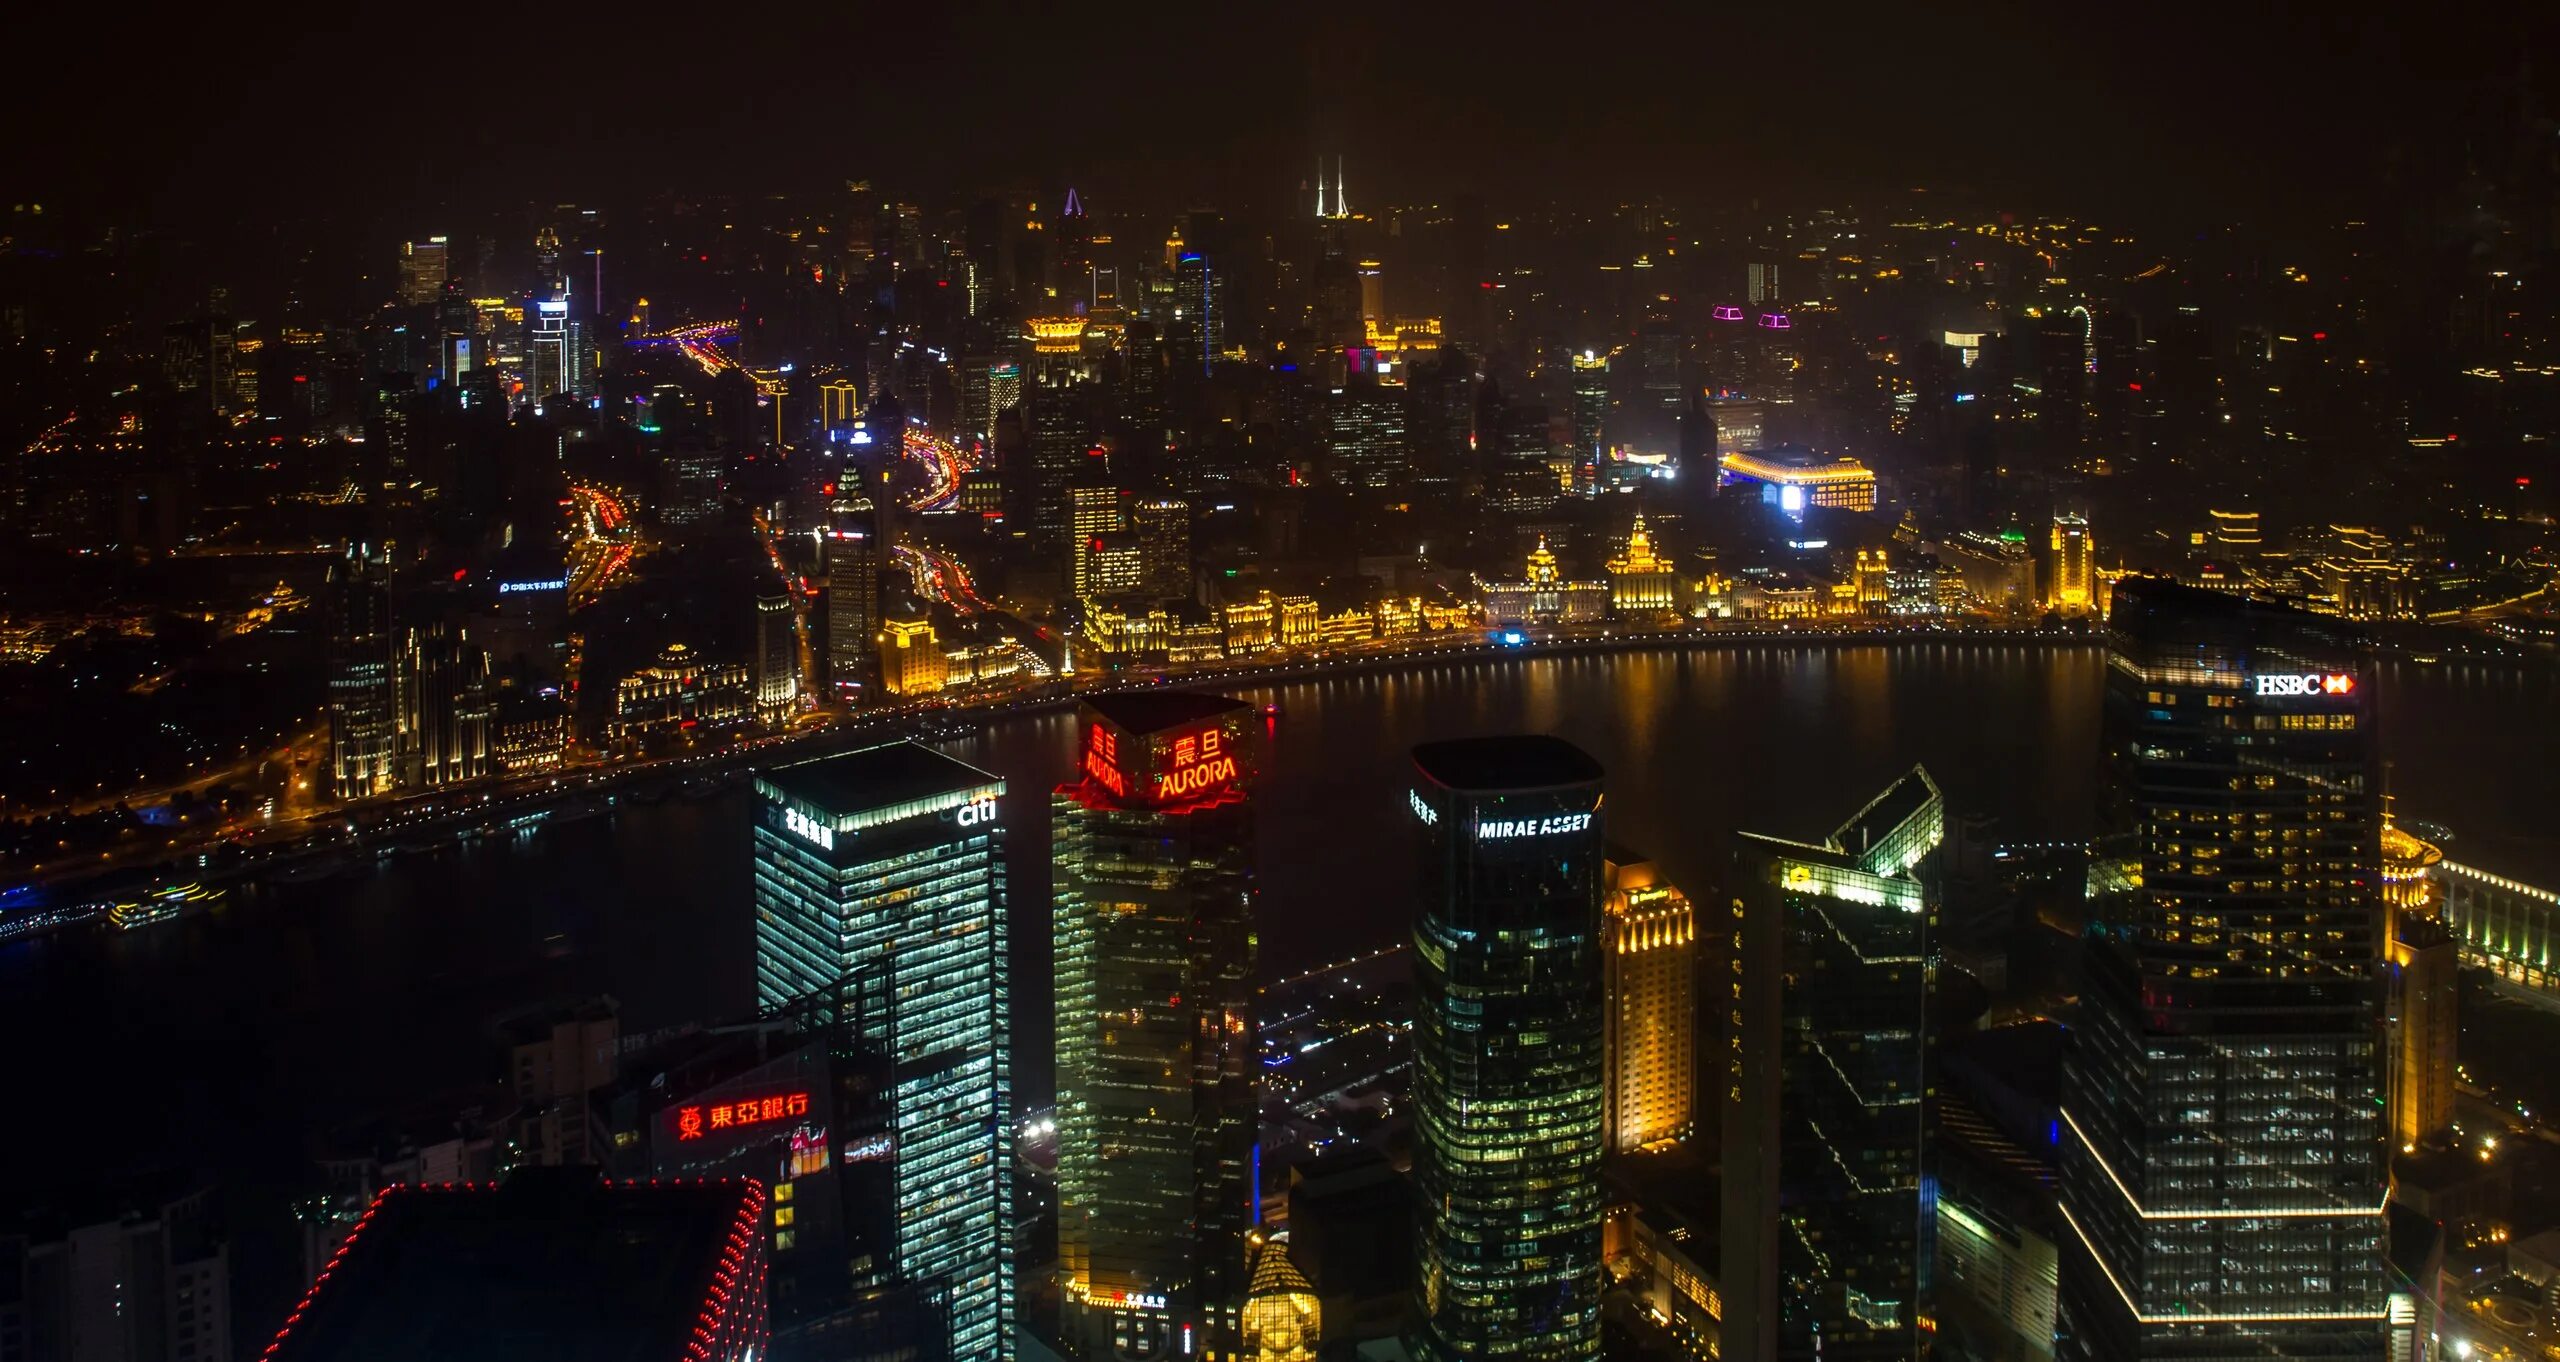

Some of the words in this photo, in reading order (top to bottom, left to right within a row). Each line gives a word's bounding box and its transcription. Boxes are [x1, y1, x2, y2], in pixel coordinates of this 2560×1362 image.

[2256, 674, 2320, 696] HSBC
[1091, 723, 1118, 765] 震旦
[1175, 729, 1222, 768] 震旦
[1086, 750, 1125, 797] AURORA
[1159, 756, 1237, 800] AURORA
[956, 796, 996, 827] citi
[1479, 819, 1538, 839] MIRAE
[1540, 813, 1592, 835] ASSET
[710, 1093, 809, 1129] 東亞銀行
